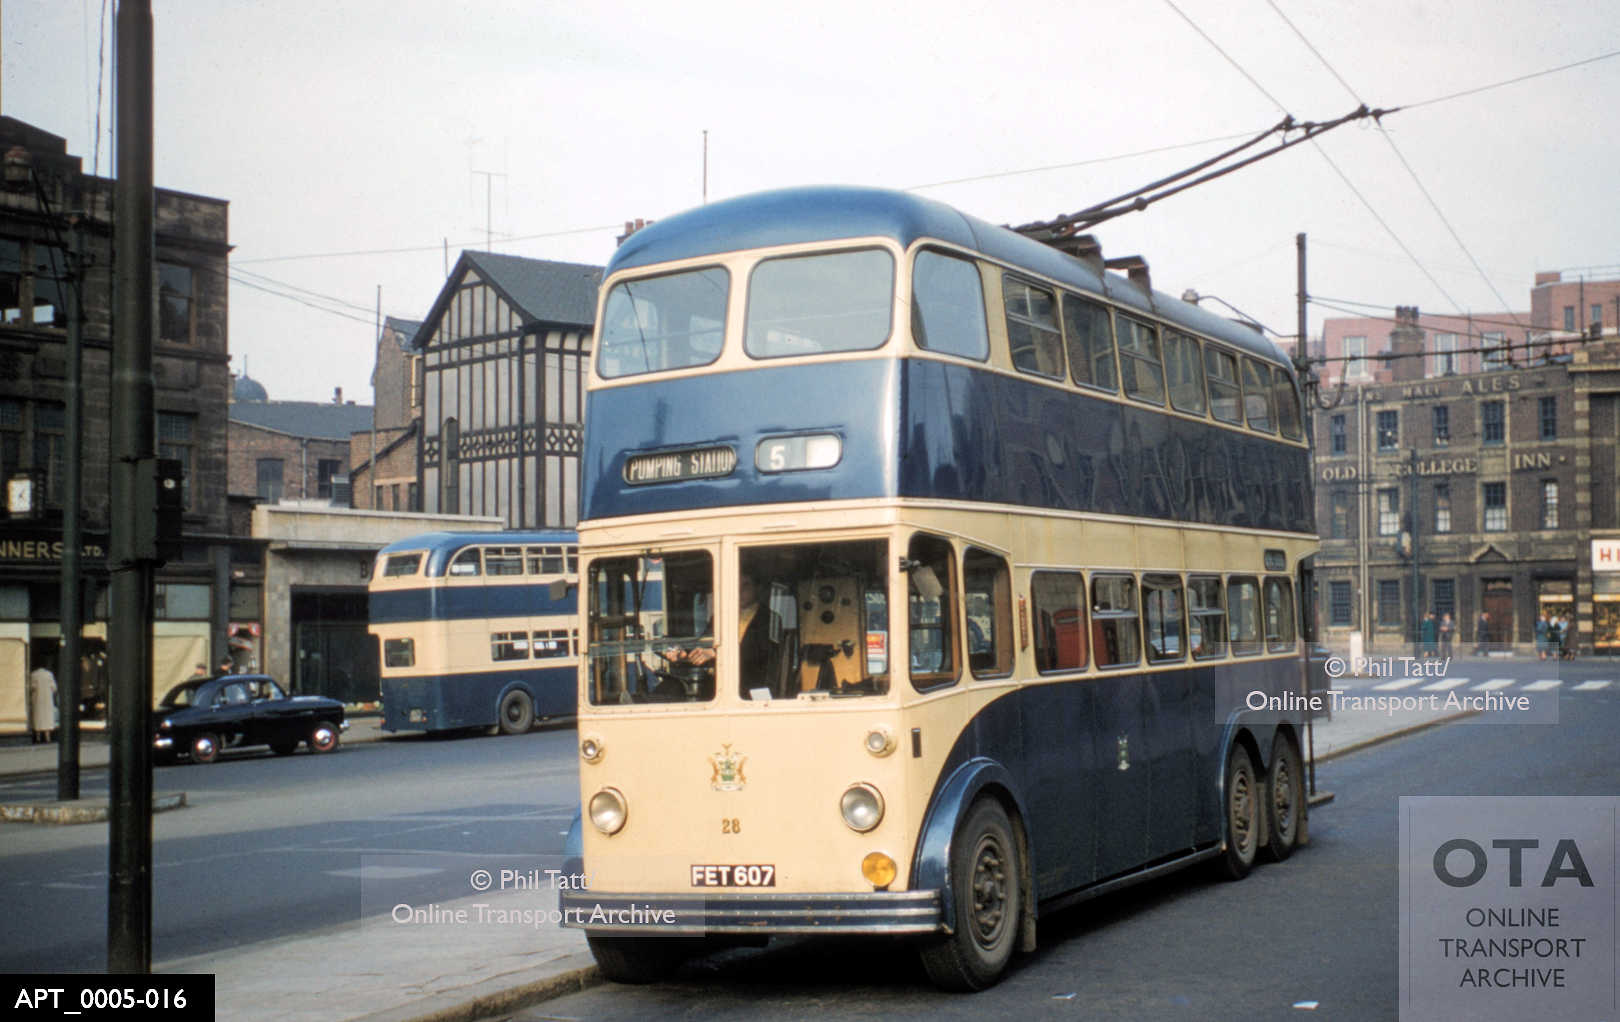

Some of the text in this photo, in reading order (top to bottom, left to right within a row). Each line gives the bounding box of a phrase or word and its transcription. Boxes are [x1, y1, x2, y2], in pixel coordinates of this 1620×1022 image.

[1462, 375, 1521, 393] ALES
[630, 455, 682, 481] PUMPING
[769, 445, 785, 471] 5
[1322, 466, 1357, 480] OLD
[1514, 453, 1551, 469] INN
[721, 818, 741, 834] 28
[692, 866, 774, 886] FET 607
